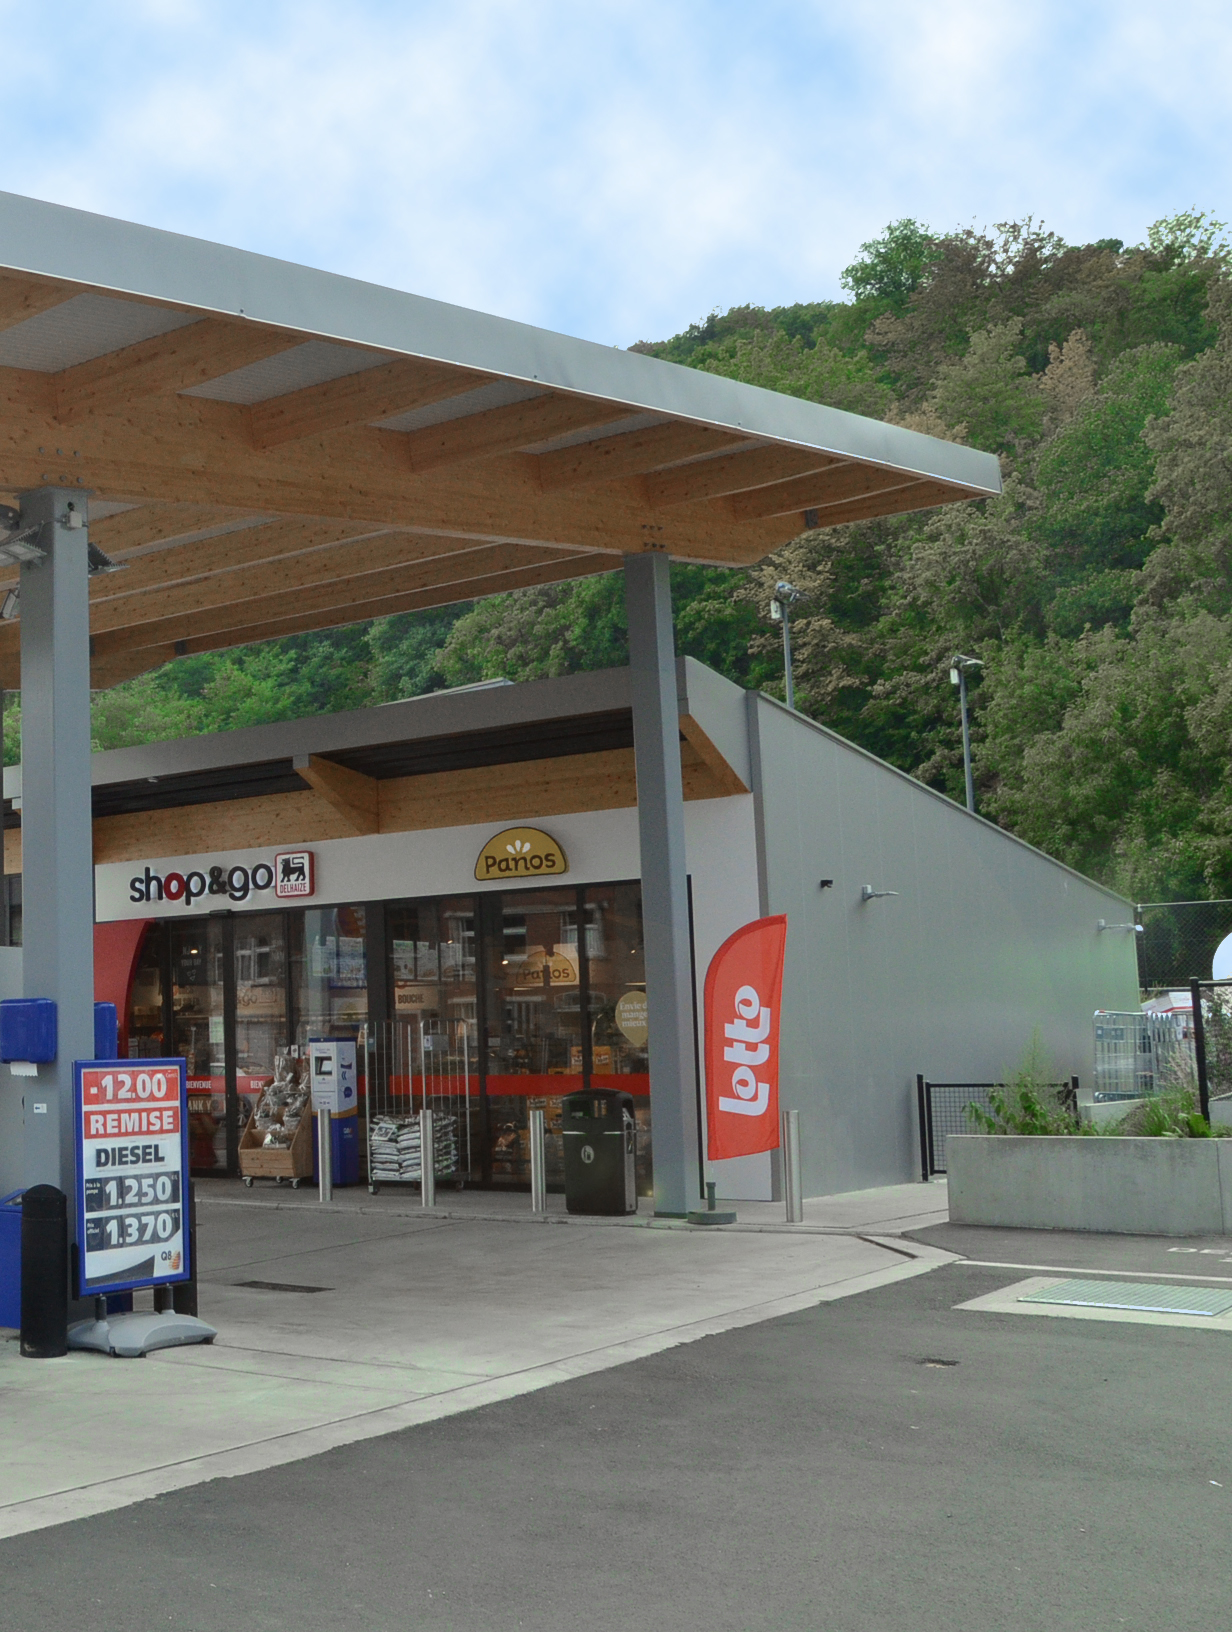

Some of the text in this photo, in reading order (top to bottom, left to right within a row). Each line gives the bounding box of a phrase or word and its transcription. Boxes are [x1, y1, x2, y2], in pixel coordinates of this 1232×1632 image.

[485, 853, 556, 874] Panos
[130, 863, 273, 906] shop&go
[280, 882, 307, 894] DELHAIZE
[523, 968, 570, 980] Paos
[719, 985, 770, 1116] Lotto
[186, 1081, 212, 1089] BIENVENUE
[90, 1110, 174, 1135] REMISE
[96, 1144, 165, 1168] DIESEL
[105, 1176, 172, 1206] 1.250
[106, 1213, 172, 1245] 1.370
[161, 1250, 172, 1261] Q8
